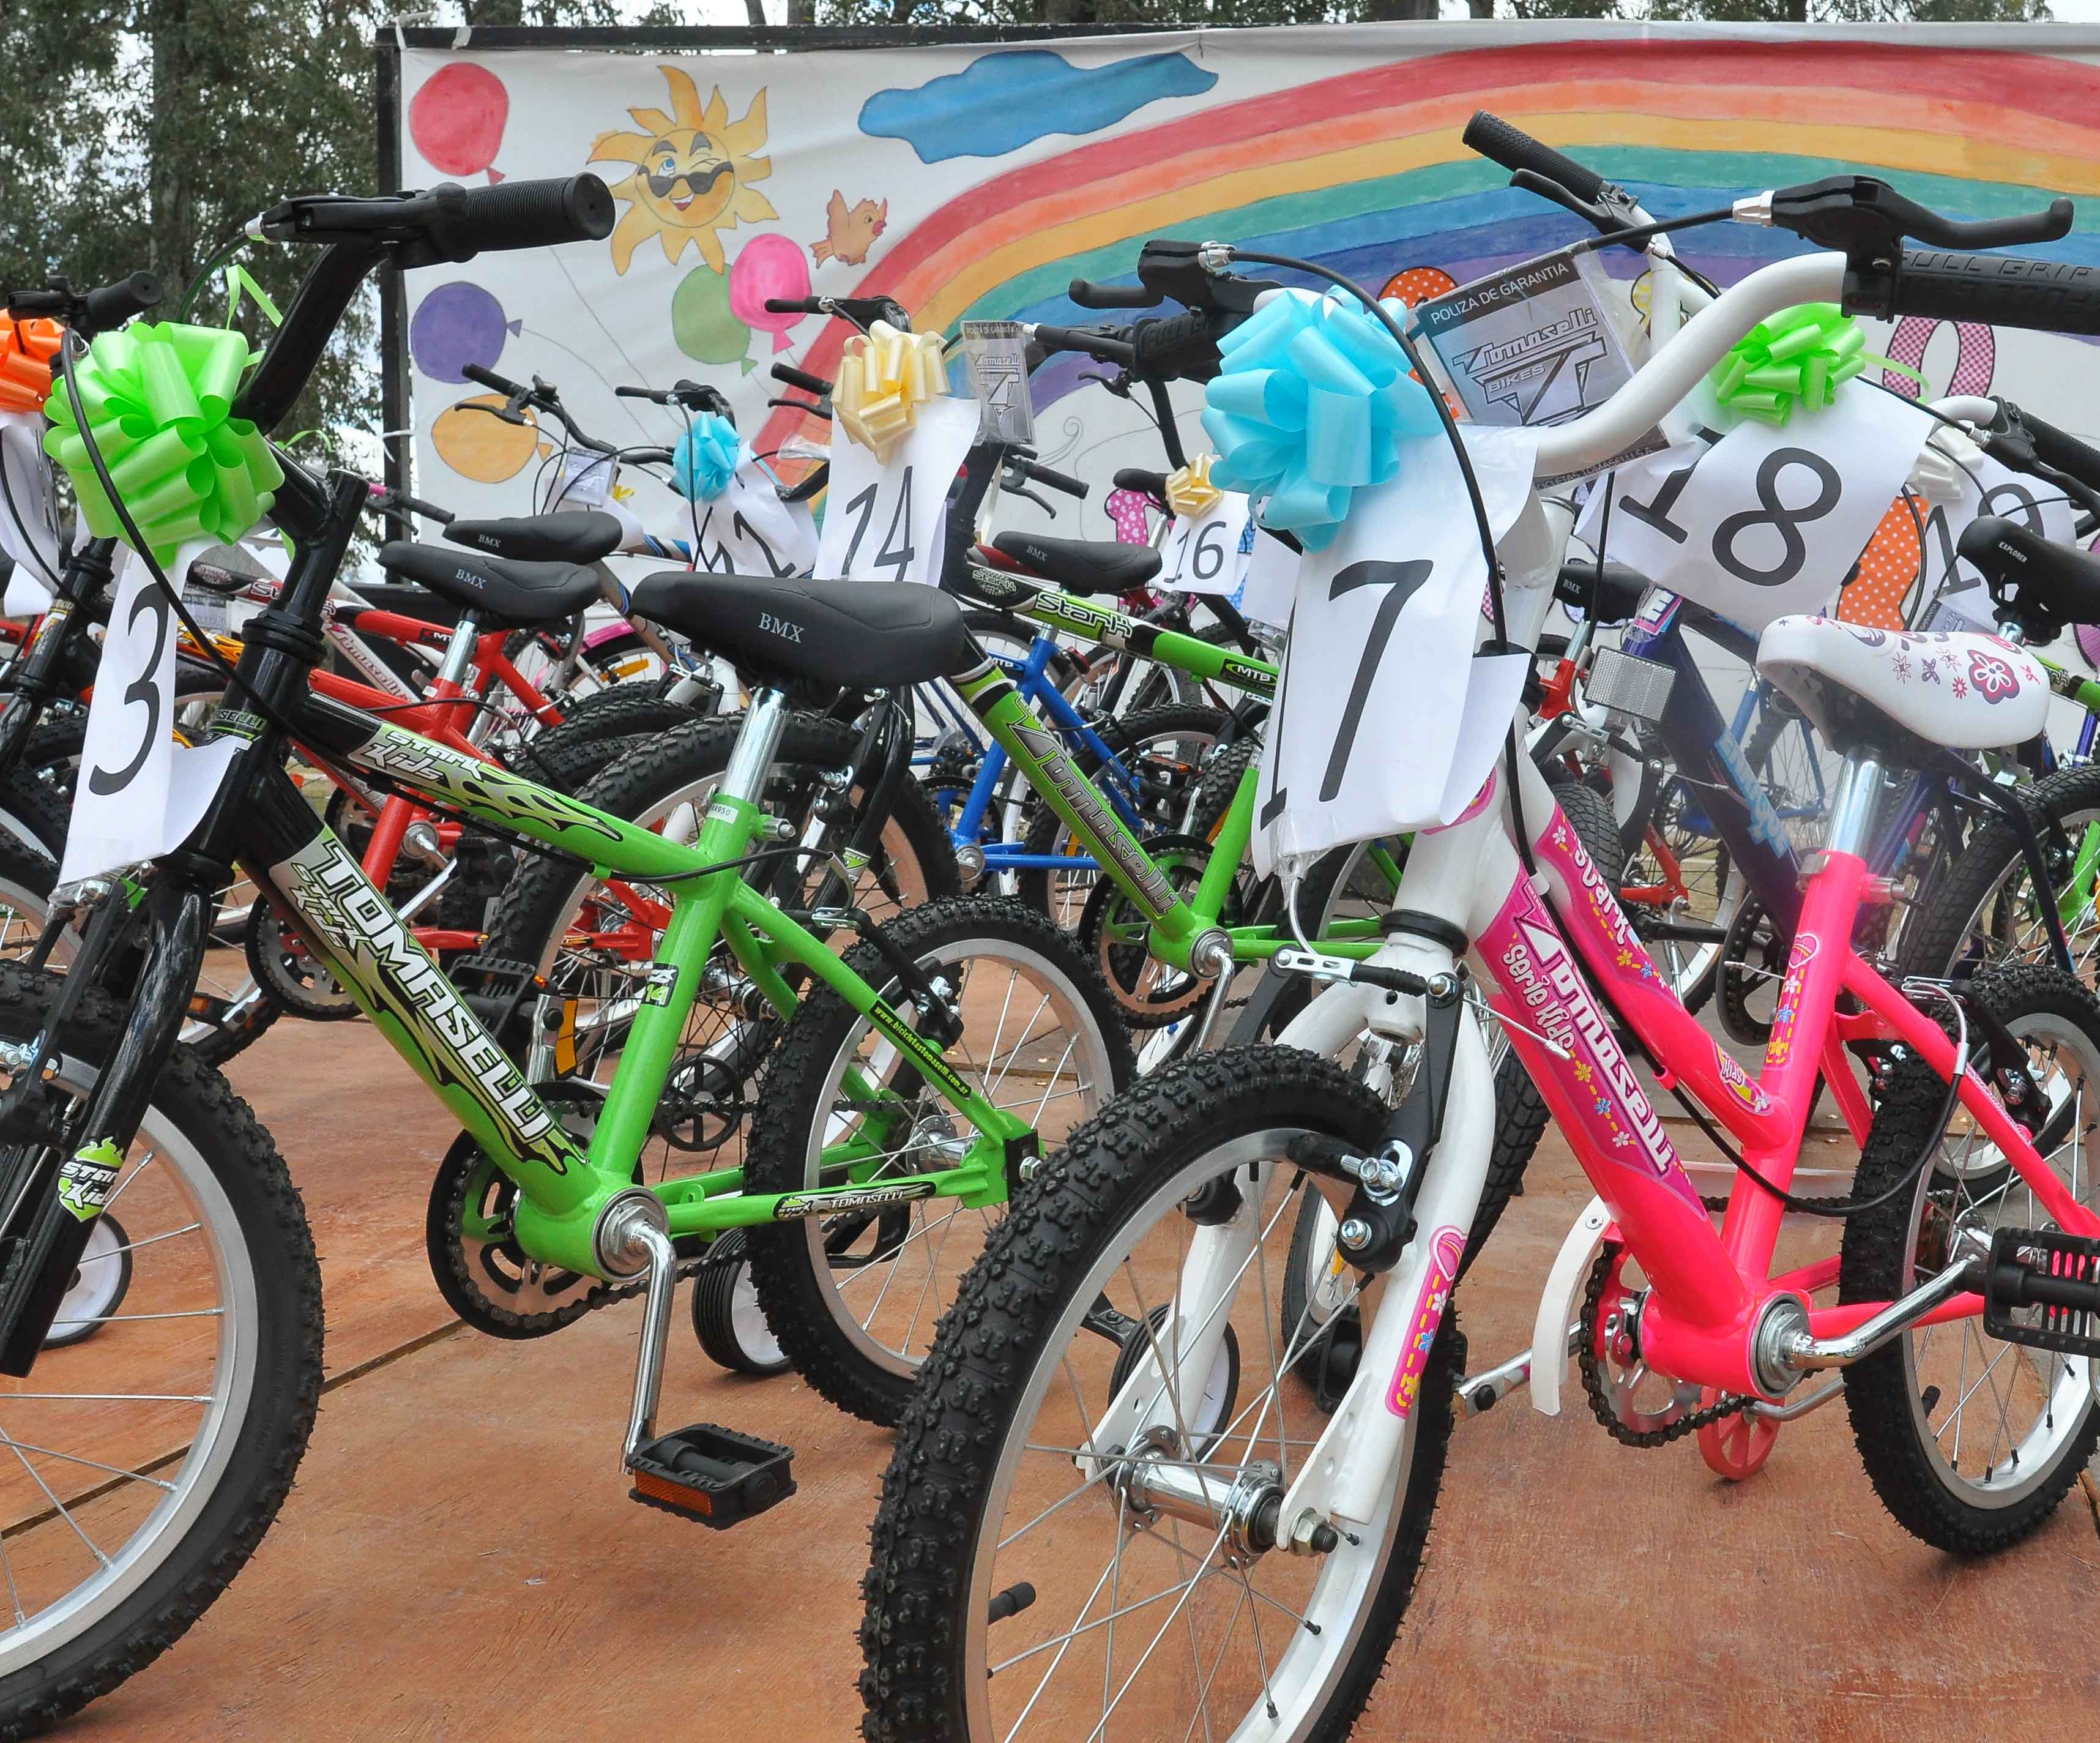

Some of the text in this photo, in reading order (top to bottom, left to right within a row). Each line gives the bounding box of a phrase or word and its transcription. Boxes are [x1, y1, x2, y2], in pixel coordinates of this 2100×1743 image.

[1998, 259, 2094, 281] GRIP
[1430, 263, 1569, 324] POLIZA DE GARANTIA
[1488, 364, 1546, 393] BIKES
[1618, 427, 1842, 586] 18
[842, 465, 915, 582] 14
[478, 534, 502, 548] BMX
[1026, 544, 1048, 562] BMX
[1163, 520, 1227, 584] 16
[1998, 541, 2028, 564] EXPLORER
[455, 567, 488, 589] BMX
[1562, 579, 1582, 594] BMX
[433, 632, 452, 643] MT
[758, 611, 806, 644] BMX
[1237, 665, 1271, 681] MTB
[89, 583, 169, 796] 3
[1260, 559, 1434, 832] 17
[311, 839, 555, 1143] TOMASELLI
[829, 1190, 904, 1209] TOMASELLI
